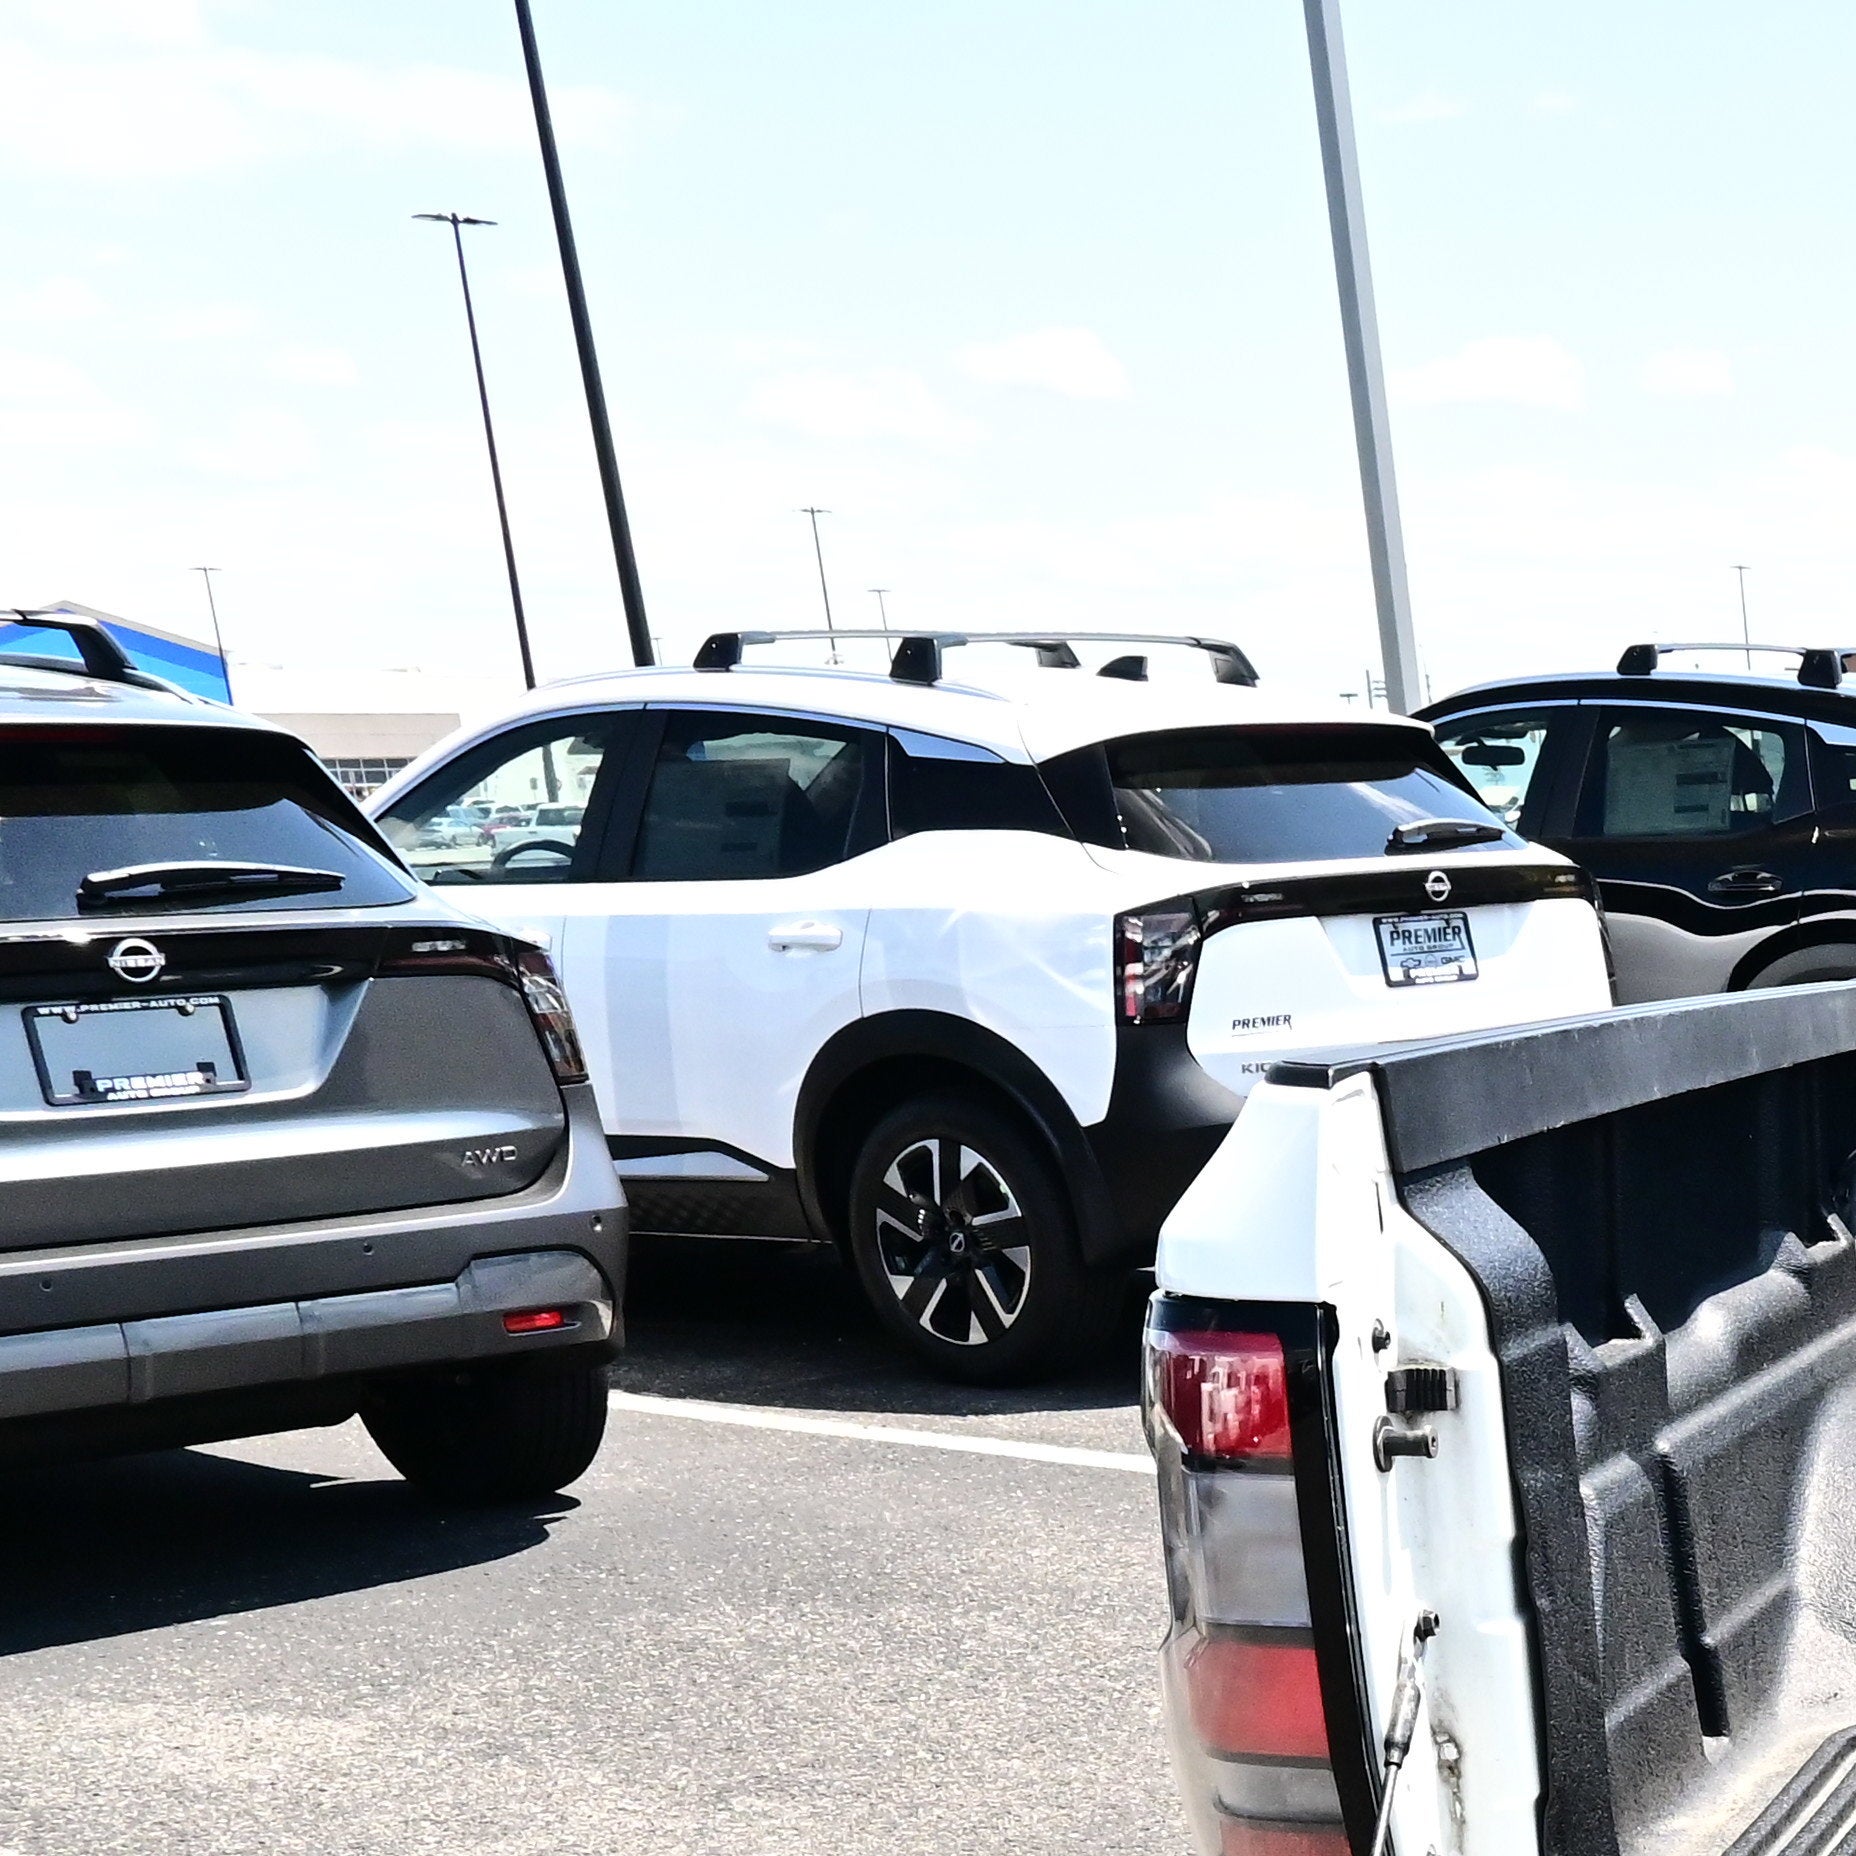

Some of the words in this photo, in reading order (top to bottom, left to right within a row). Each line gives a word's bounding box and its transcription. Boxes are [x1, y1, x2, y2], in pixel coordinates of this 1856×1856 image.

[1389, 925, 1464, 948] PREMIER
[109, 953, 166, 968] NISSAN
[1232, 1014, 1293, 1031] PREMIER
[96, 1071, 205, 1092] PREMIER
[461, 1145, 518, 1168] AWD
